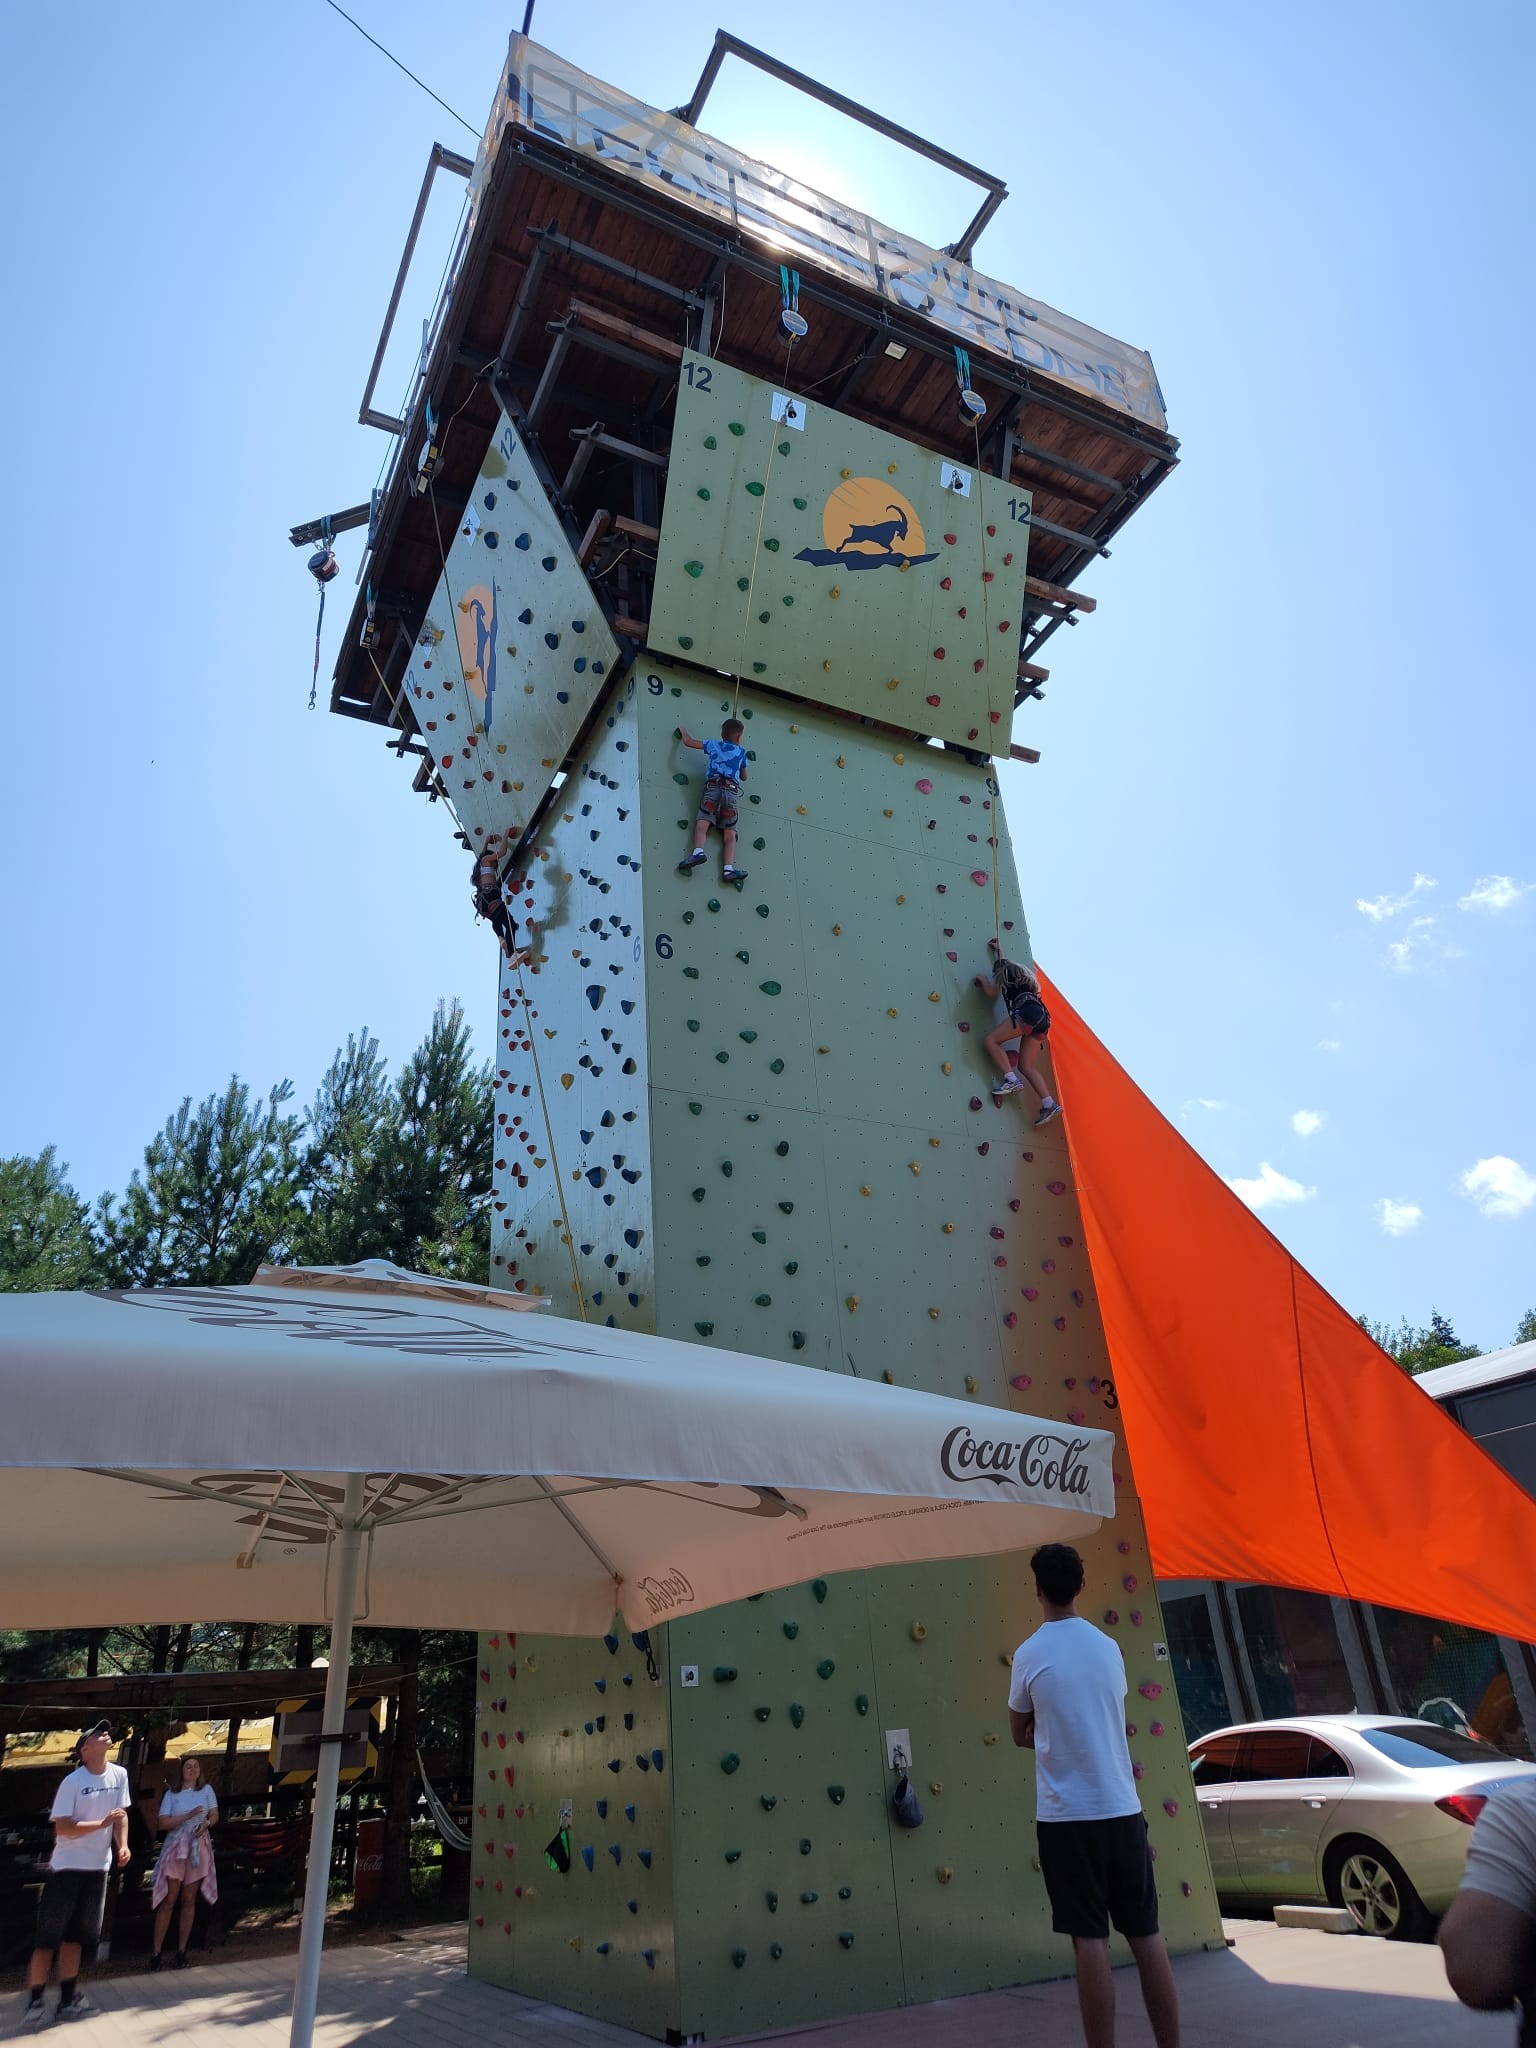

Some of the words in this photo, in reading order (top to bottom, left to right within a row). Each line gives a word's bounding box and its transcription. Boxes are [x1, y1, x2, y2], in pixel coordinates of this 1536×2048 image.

[682, 361, 713, 393] 12
[500, 427, 517, 461] 12
[1007, 498, 1031, 526] 12
[647, 674, 664, 696] 9
[985, 777, 1000, 797] 9
[633, 935, 641, 963] 6
[655, 933, 674, 960] 6
[1100, 1379, 1119, 1410] 3
[940, 1425, 1092, 1495] Coca-Cola
